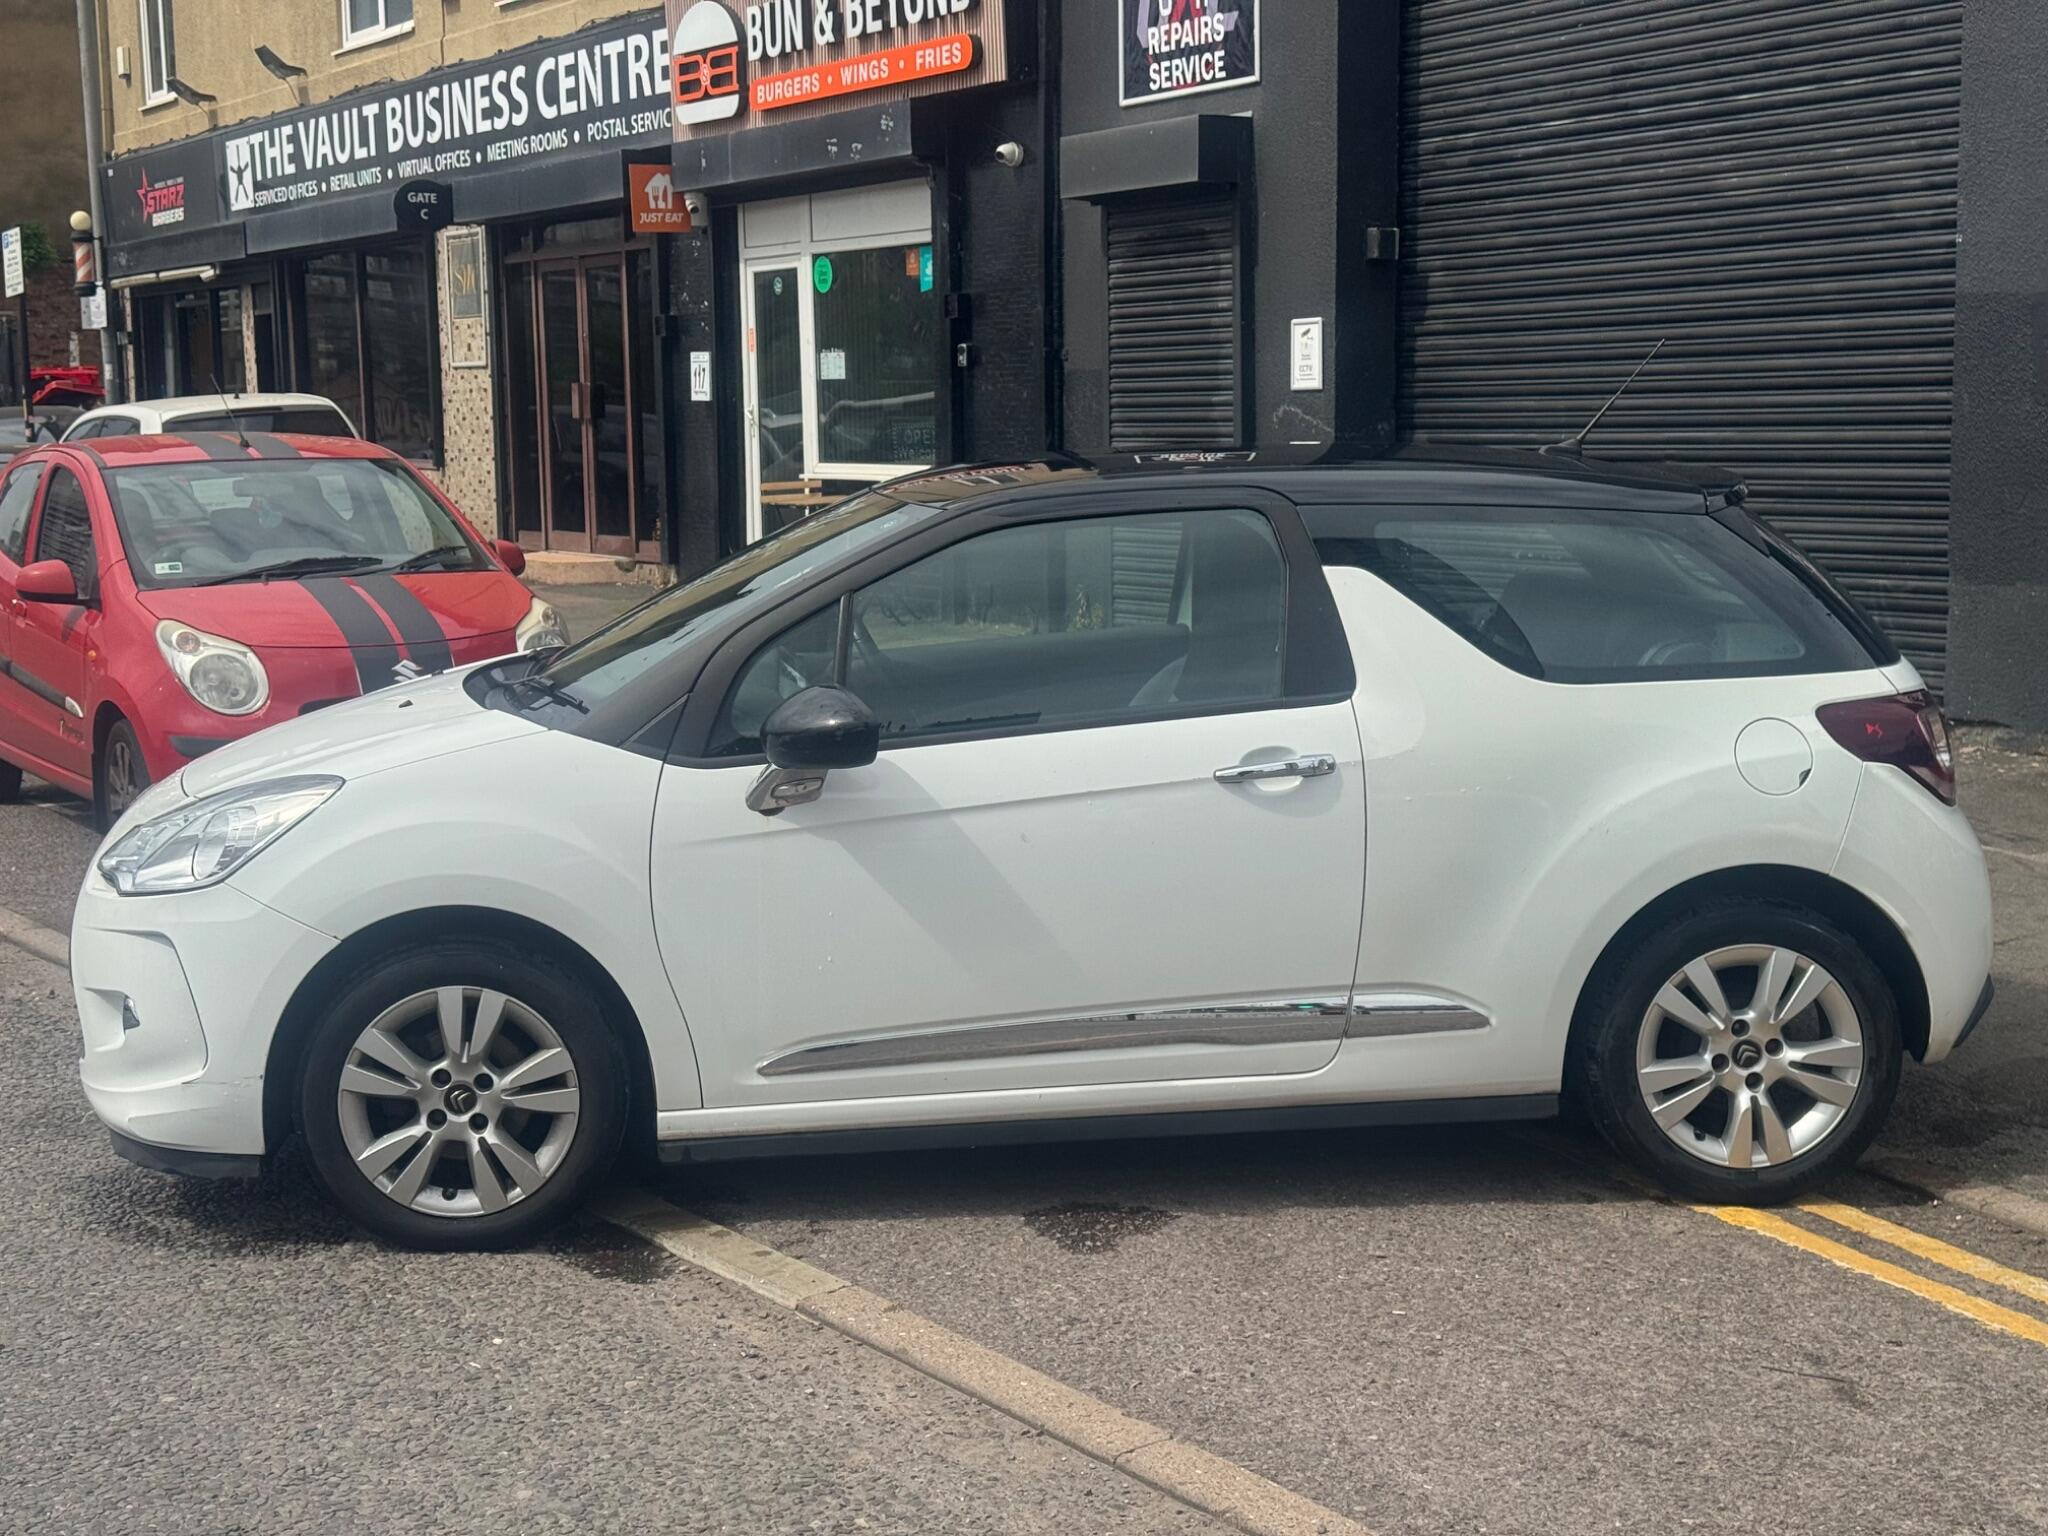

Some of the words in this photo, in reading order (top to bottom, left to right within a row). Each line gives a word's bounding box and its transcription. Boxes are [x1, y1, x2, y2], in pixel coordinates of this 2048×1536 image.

[747, 0, 803, 61] BUN
[813, 0, 836, 46] &
[846, 0, 970, 38] BEY
[1148, 12, 1225, 55] REPAIRS
[757, 76, 820, 104] BURGERS
[840, 58, 889, 86] WINGS
[915, 42, 962, 71] FRIES
[1149, 50, 1226, 91] SERVICE
[250, 125, 296, 181] THE
[298, 103, 379, 170] VAULT
[385, 65, 529, 153] BUSINESS
[536, 28, 671, 119] CENTRE
[254, 187, 287, 207] SERVICED
[330, 171, 357, 192] RETAIL
[357, 167, 382, 186] UNITS
[397, 157, 434, 179] VIRTUAL
[434, 149, 471, 171] OFFICES
[486, 136, 529, 162] MEETING
[531, 129, 568, 153] ROOMS
[587, 118, 629, 143] POSTAL
[146, 184, 185, 212] STARZ
[407, 192, 438, 203] GATE
[420, 209, 429, 219] C
[640, 213, 664, 223] JUST
[665, 212, 684, 223] EAT
